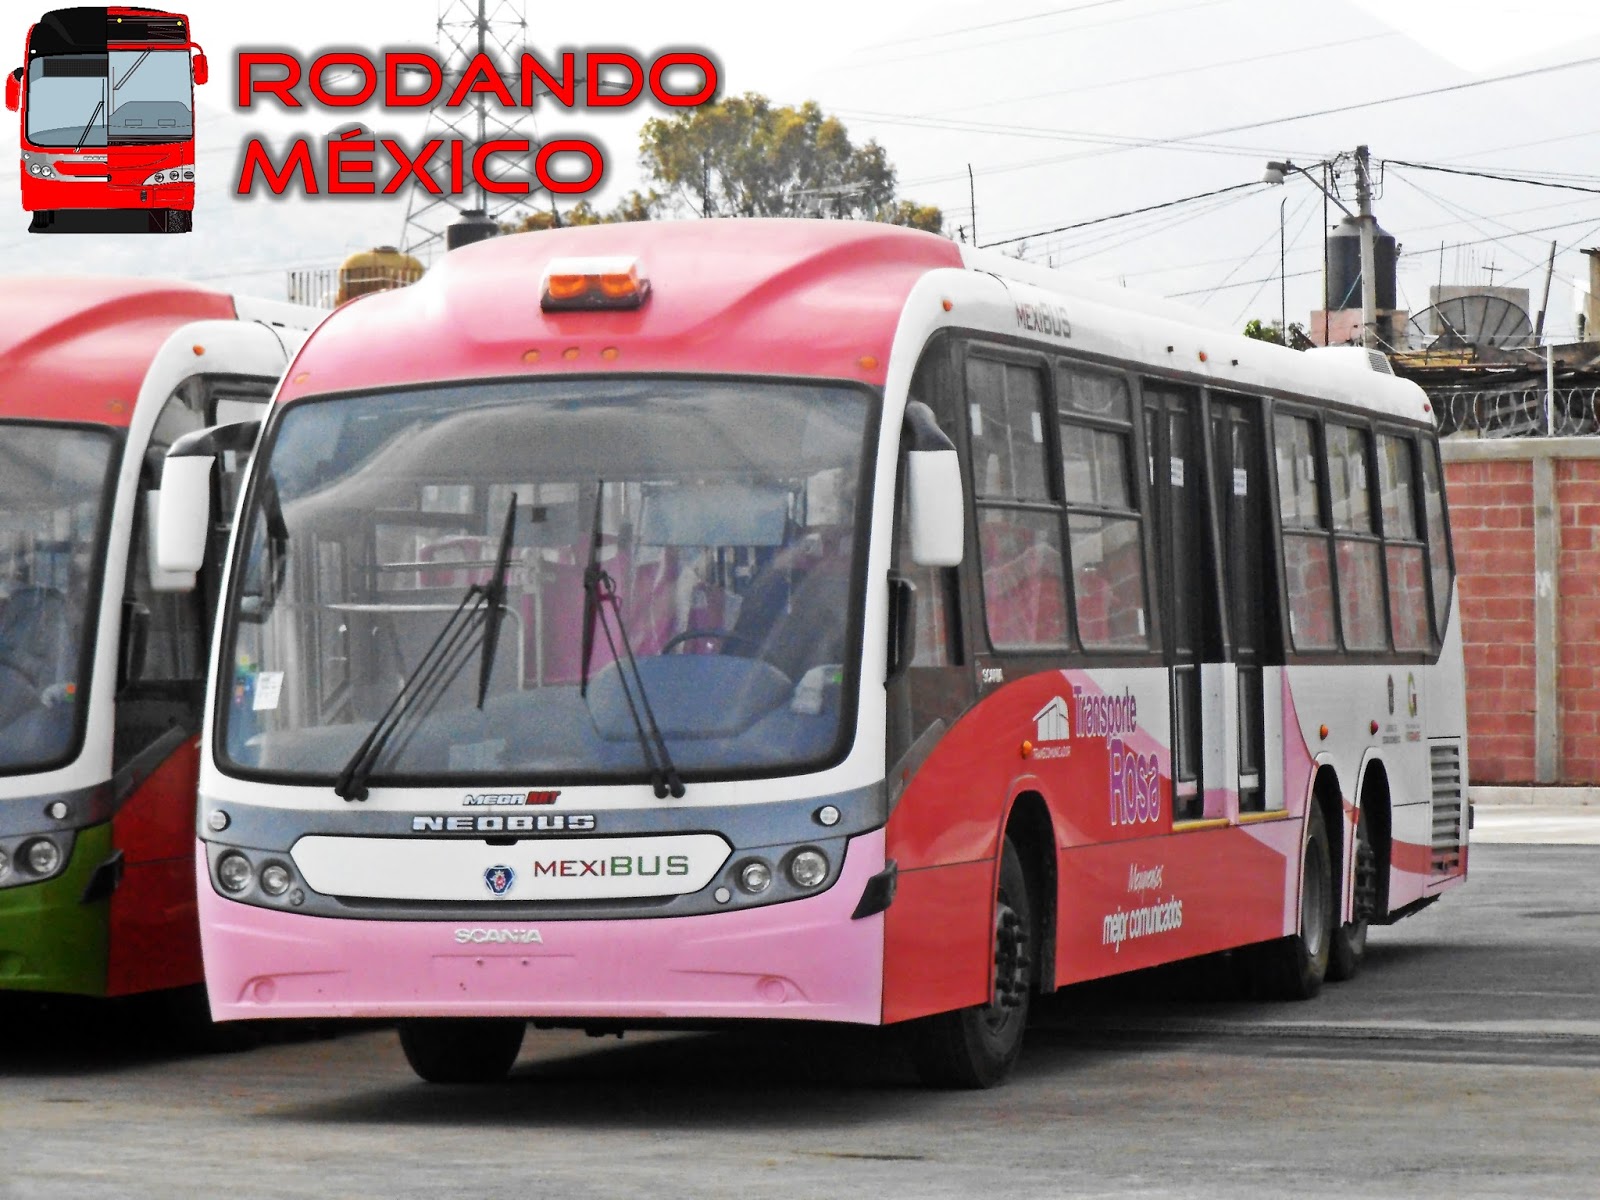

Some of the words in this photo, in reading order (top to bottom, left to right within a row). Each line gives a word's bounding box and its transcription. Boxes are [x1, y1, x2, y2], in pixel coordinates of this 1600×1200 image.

[1015, 301, 1071, 339] MEXIBUS
[1073, 685, 1137, 750] Transporte
[1109, 737, 1160, 826] Rosa
[462, 793, 526, 806] MEGA
[412, 814, 595, 831] NEOBUS
[534, 855, 689, 878] MEXIBUS
[454, 927, 544, 945] SCANIA
[1102, 905, 1129, 953] mejor
[1129, 894, 1183, 939] comunicados
